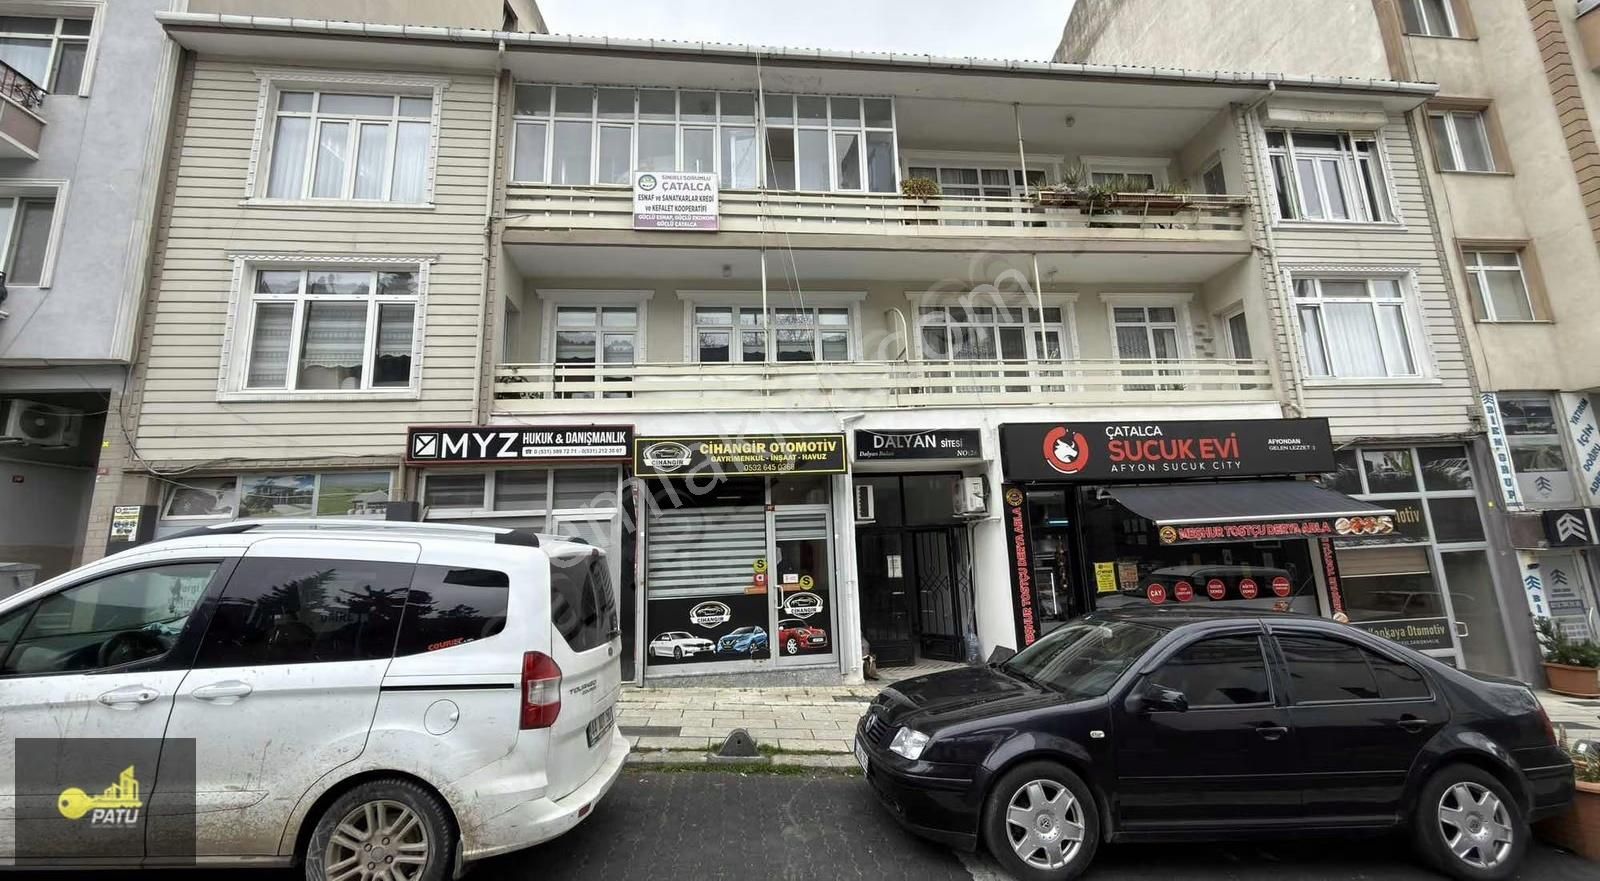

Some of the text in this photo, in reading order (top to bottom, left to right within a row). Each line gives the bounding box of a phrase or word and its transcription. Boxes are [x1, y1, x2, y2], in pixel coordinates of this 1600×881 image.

[662, 182, 712, 192] ÇATALCA
[522, 431, 626, 446] HUKUK & DANIŞMANLIK
[1105, 426, 1163, 440] ÇATALCA
[441, 432, 520, 458] MYZ
[700, 439, 837, 454] CİHANGİR OTOMOTİV
[873, 434, 937, 448] DALYAN
[1108, 432, 1240, 462] SUCUK EVİ
[711, 454, 765, 462] GAYRİMENKUL
[1111, 461, 1241, 472] AFYON SUCUK CITY
[757, 560, 764, 568] S
[803, 576, 810, 585] S
[1022, 607, 1036, 646] EŞHUR
[1407, 624, 1445, 636] Otomotiv
